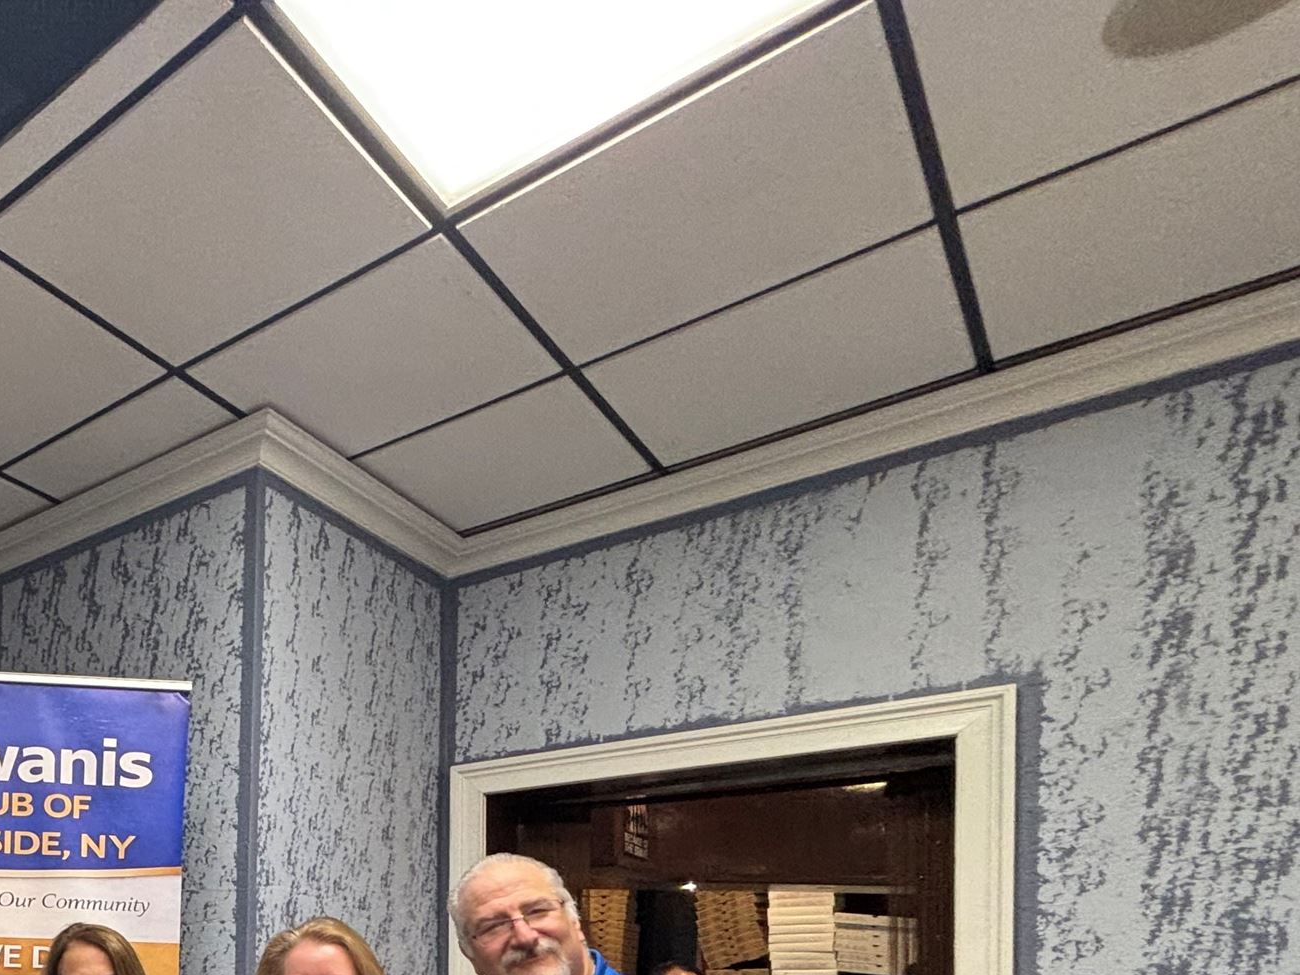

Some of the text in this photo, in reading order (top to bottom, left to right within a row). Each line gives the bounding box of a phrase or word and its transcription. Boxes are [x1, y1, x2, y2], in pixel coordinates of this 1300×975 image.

[43, 793, 92, 819] OF
[80, 833, 136, 860] NY
[41, 892, 151, 917] Community
